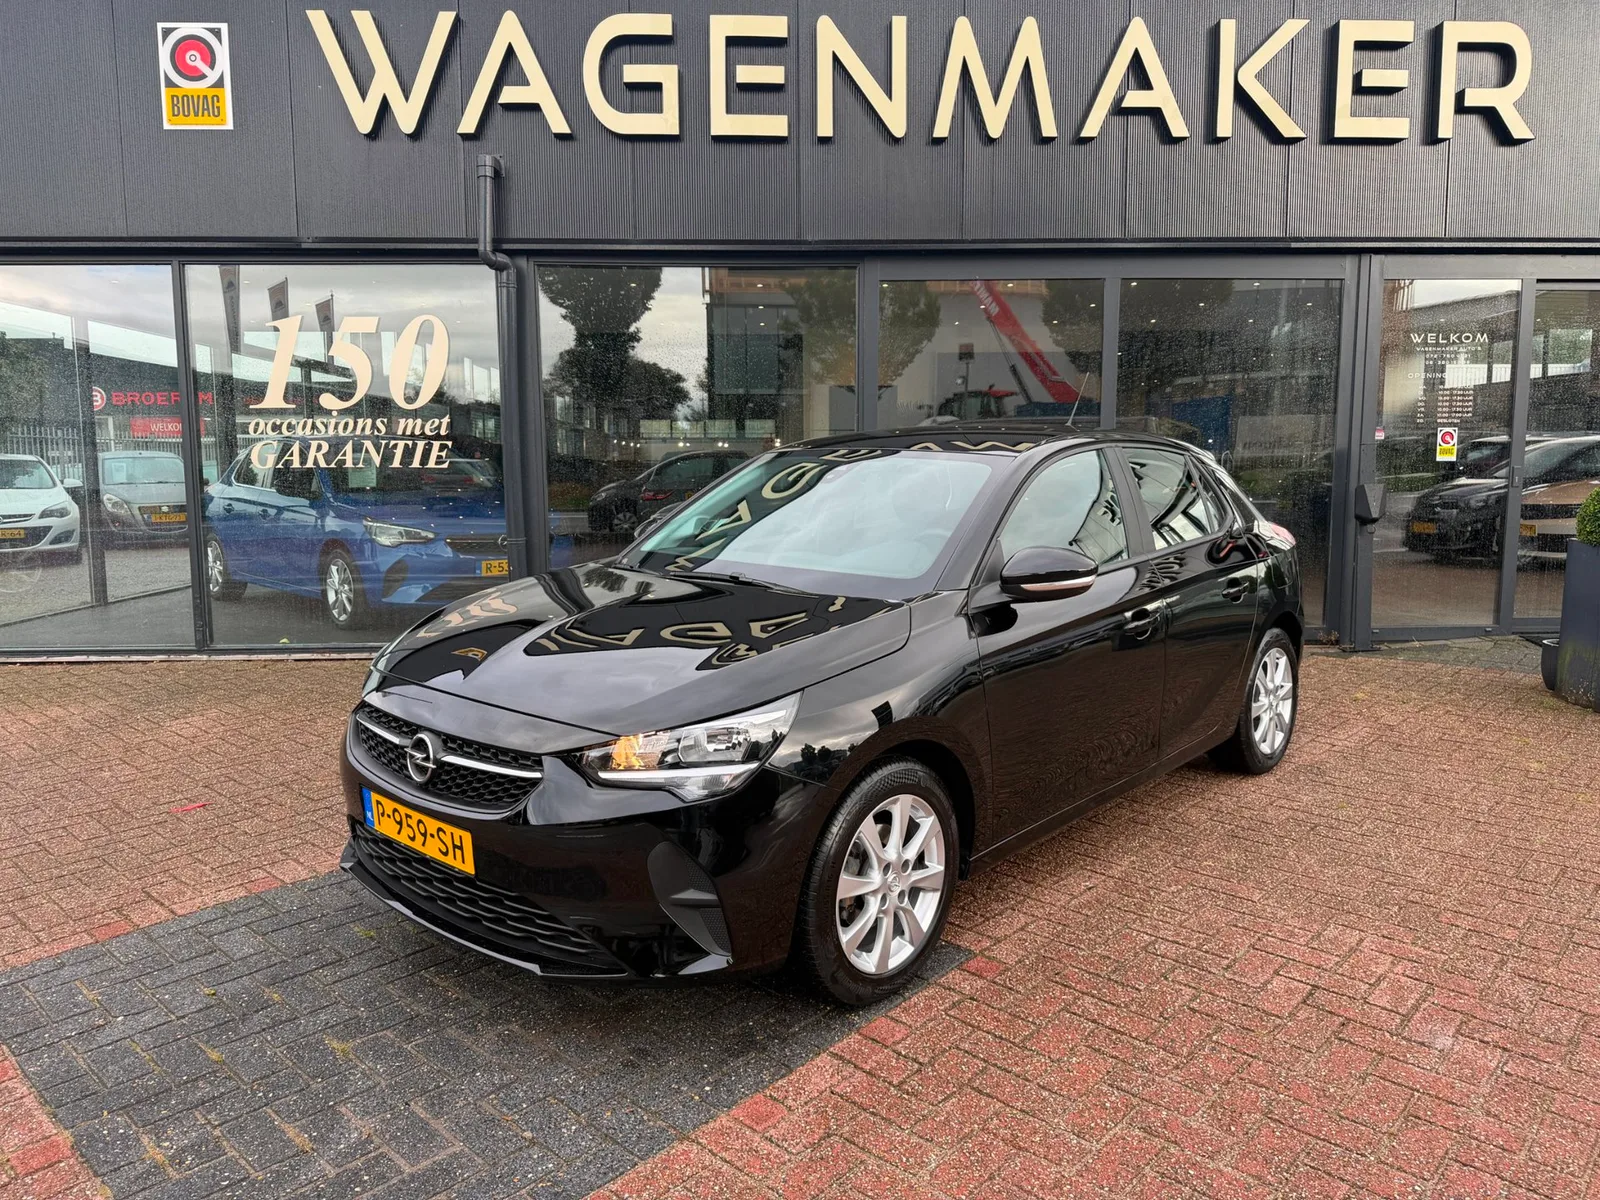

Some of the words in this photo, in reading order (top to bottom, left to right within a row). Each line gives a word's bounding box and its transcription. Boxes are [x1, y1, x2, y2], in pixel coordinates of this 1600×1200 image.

[305, 10, 1534, 140] WAGENMAKER
[171, 94, 220, 118] BOVAG
[1410, 333, 1489, 343] WELKOM
[249, 314, 450, 410] 150
[150, 423, 182, 432] WELKO
[248, 411, 388, 436] occasions
[397, 414, 451, 436] met
[250, 440, 453, 469] GARANTIE
[376, 799, 465, 864] P-959-SH
